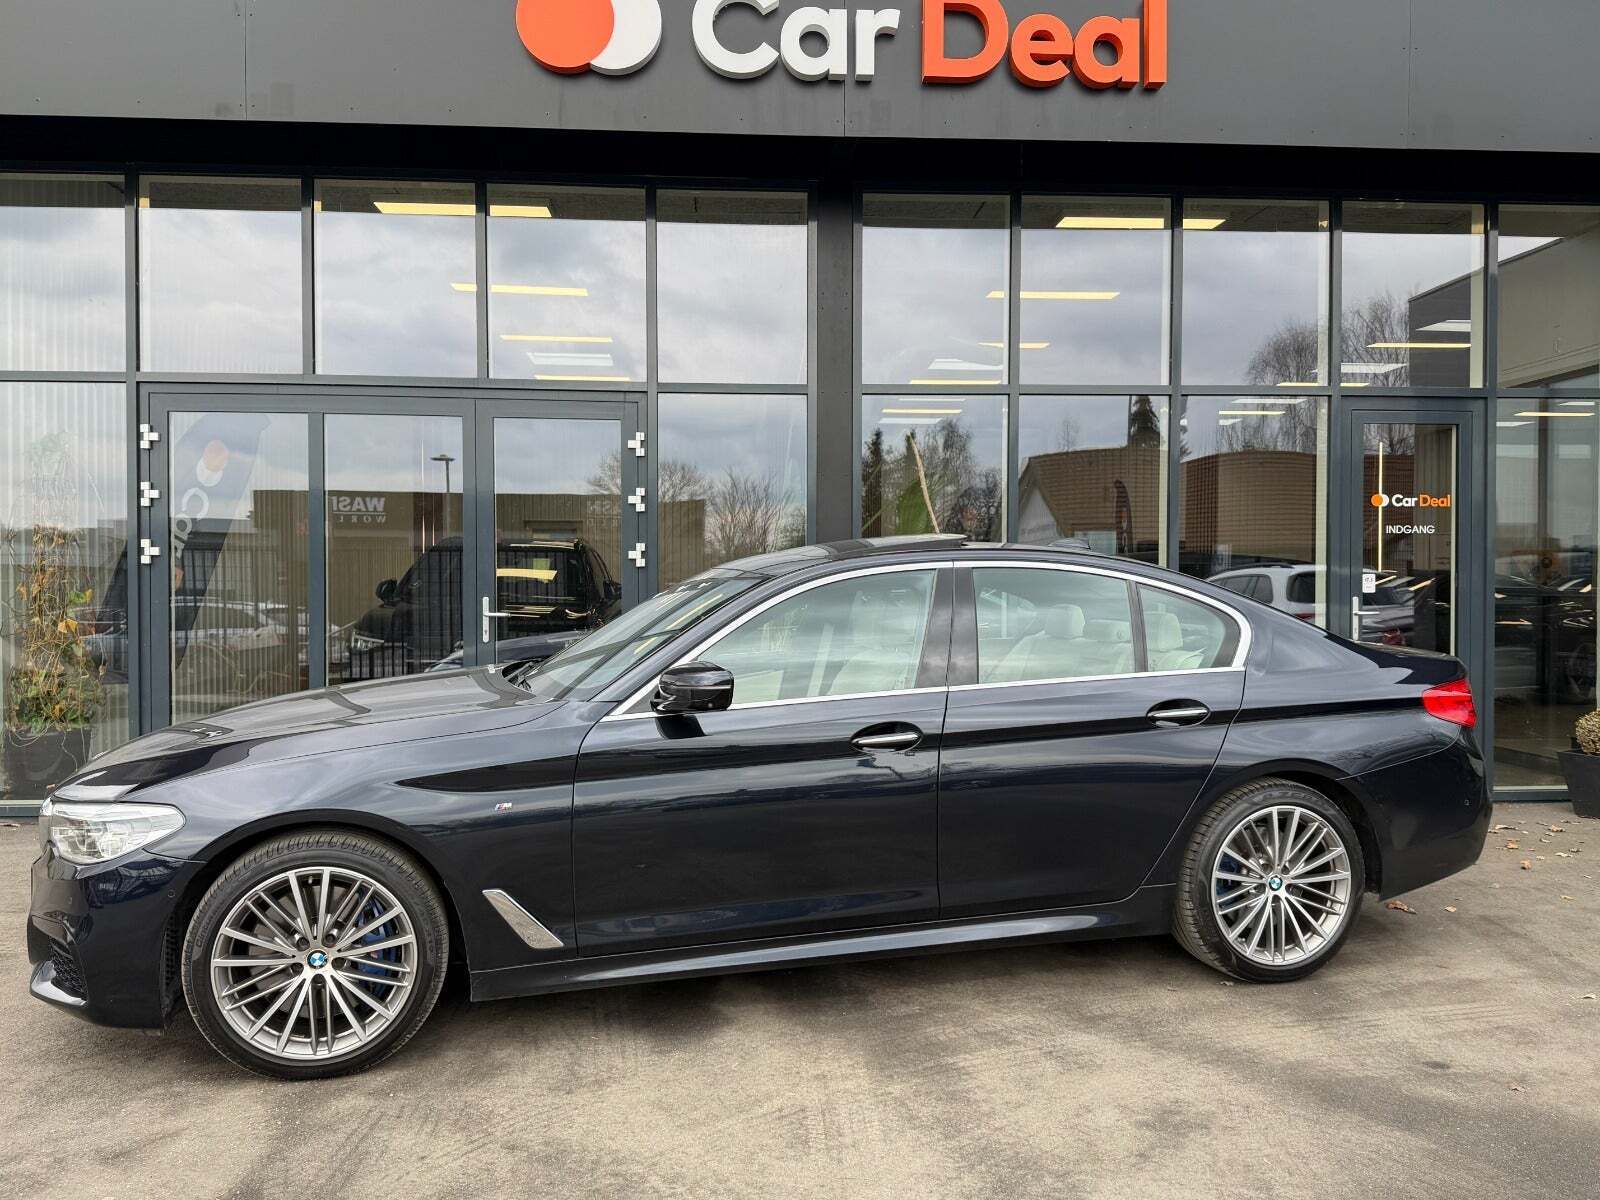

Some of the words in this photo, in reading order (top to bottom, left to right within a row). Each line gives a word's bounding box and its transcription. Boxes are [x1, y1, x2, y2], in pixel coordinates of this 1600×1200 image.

[692, 0, 901, 82] Car
[921, 0, 1168, 90] Deal
[1392, 494, 1418, 507] Car
[1420, 494, 1451, 507] Deal
[1386, 525, 1435, 534] INDGANG
